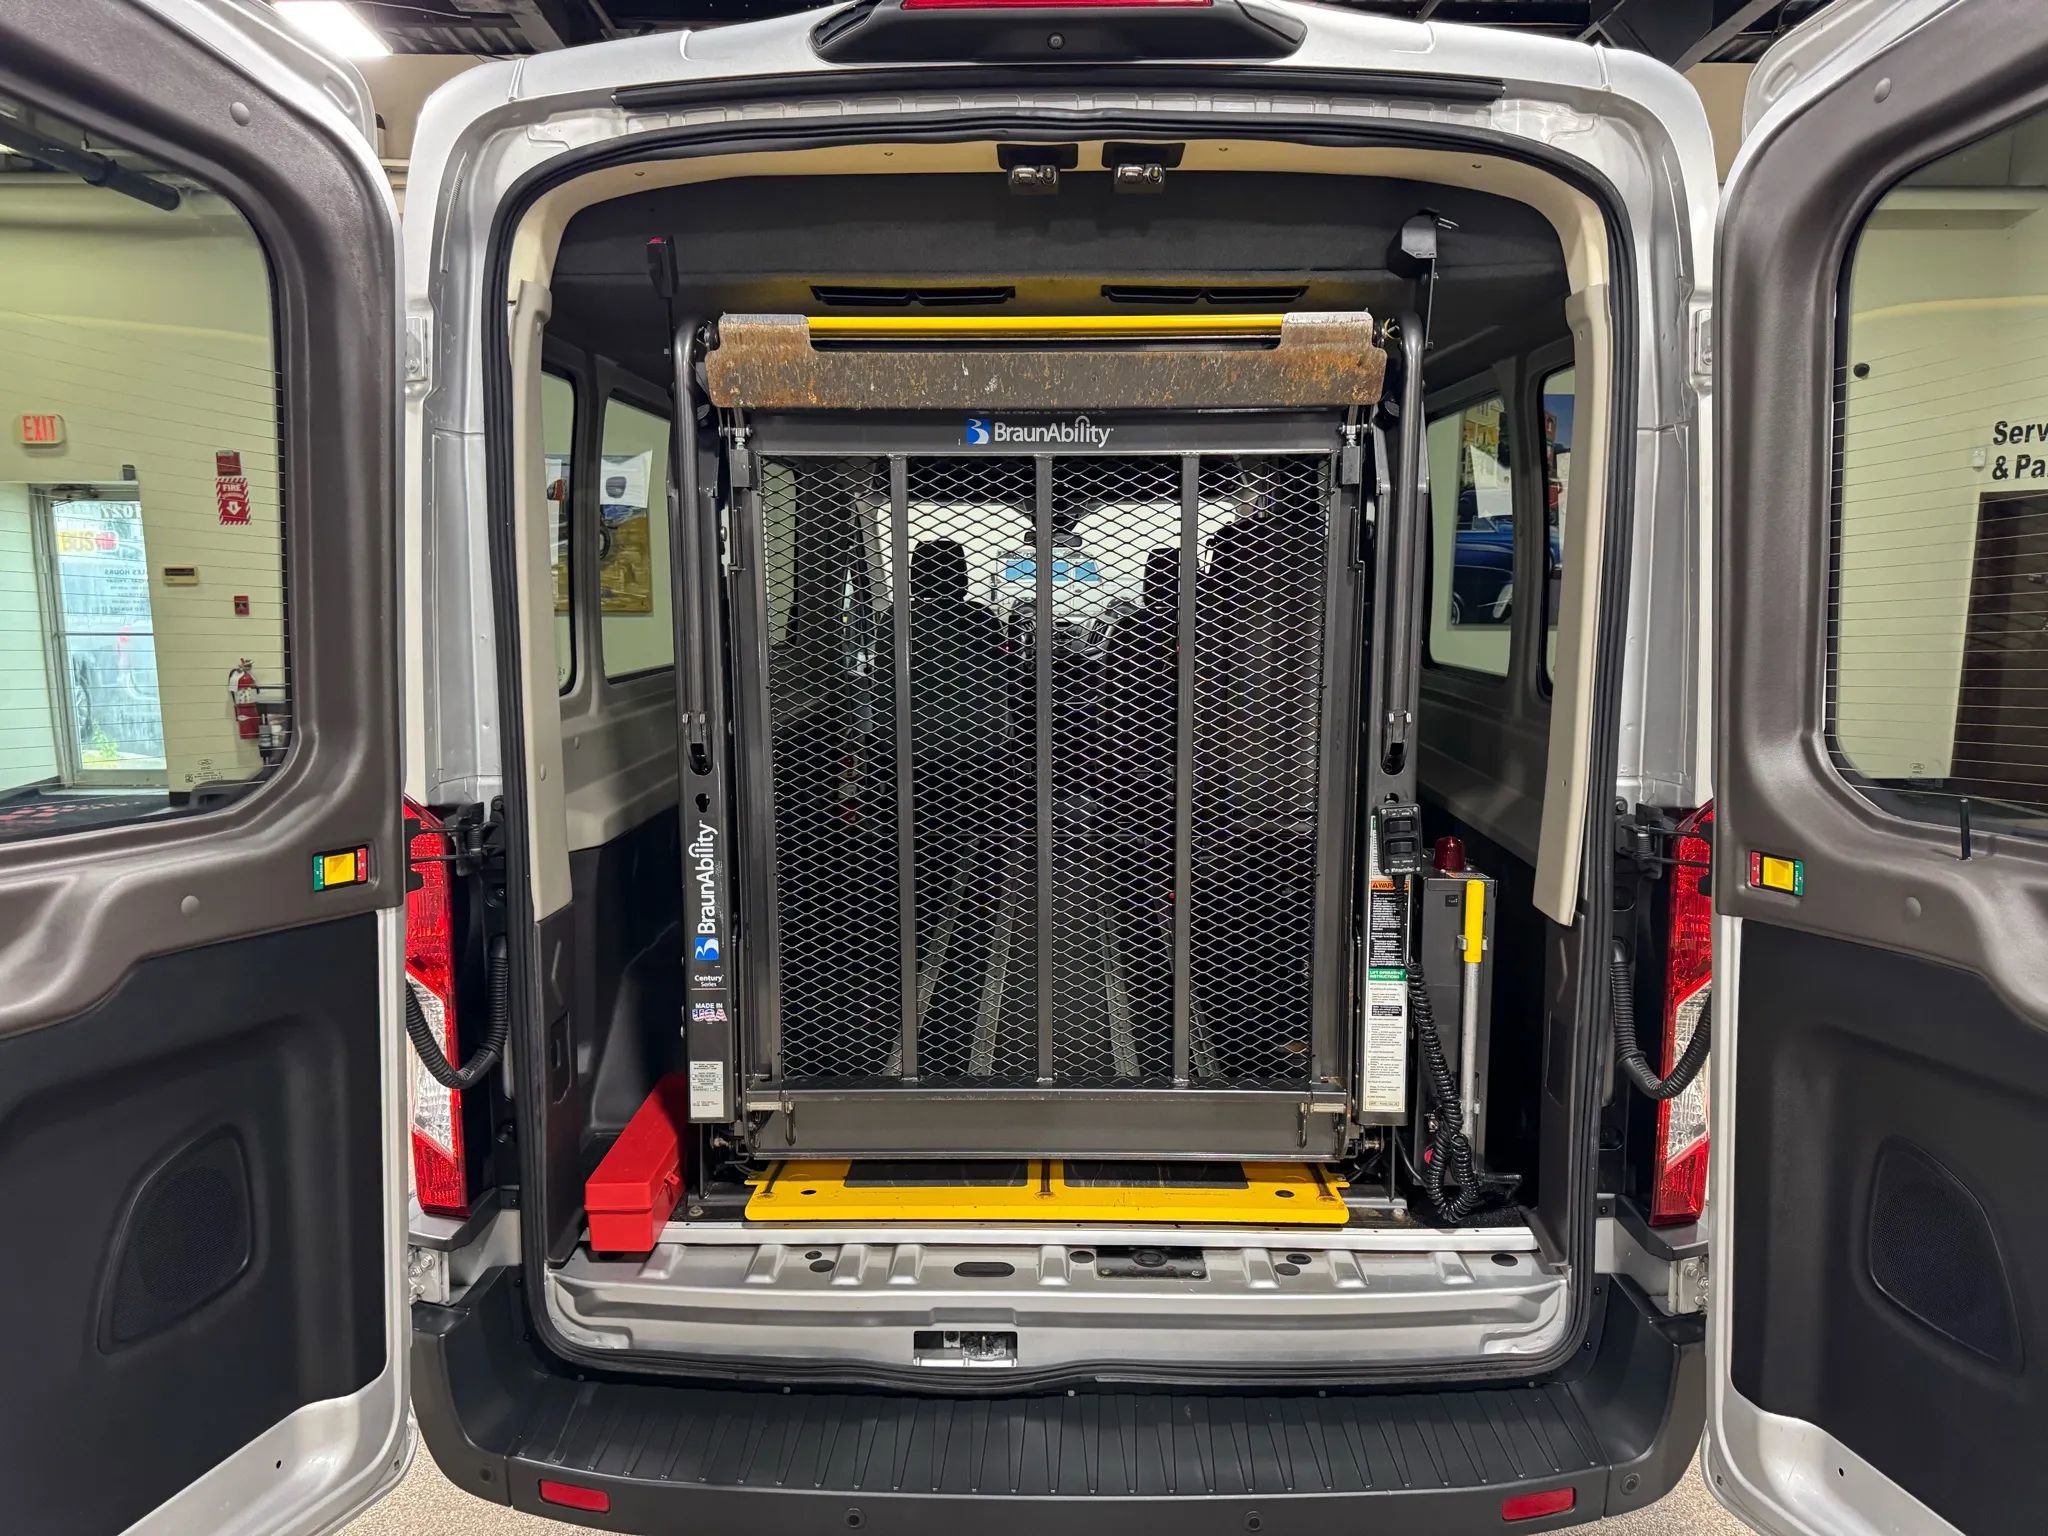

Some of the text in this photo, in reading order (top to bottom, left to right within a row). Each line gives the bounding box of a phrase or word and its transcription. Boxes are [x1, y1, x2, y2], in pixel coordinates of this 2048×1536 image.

[22, 415, 56, 442] EXIT
[994, 415, 1110, 448] BraunAbility
[1992, 454, 2048, 480] & Pa
[222, 484, 242, 492] FIRE
[688, 822, 719, 934] BraunAbility
[694, 974, 723, 982] Century
[691, 1008, 728, 1022] USA
